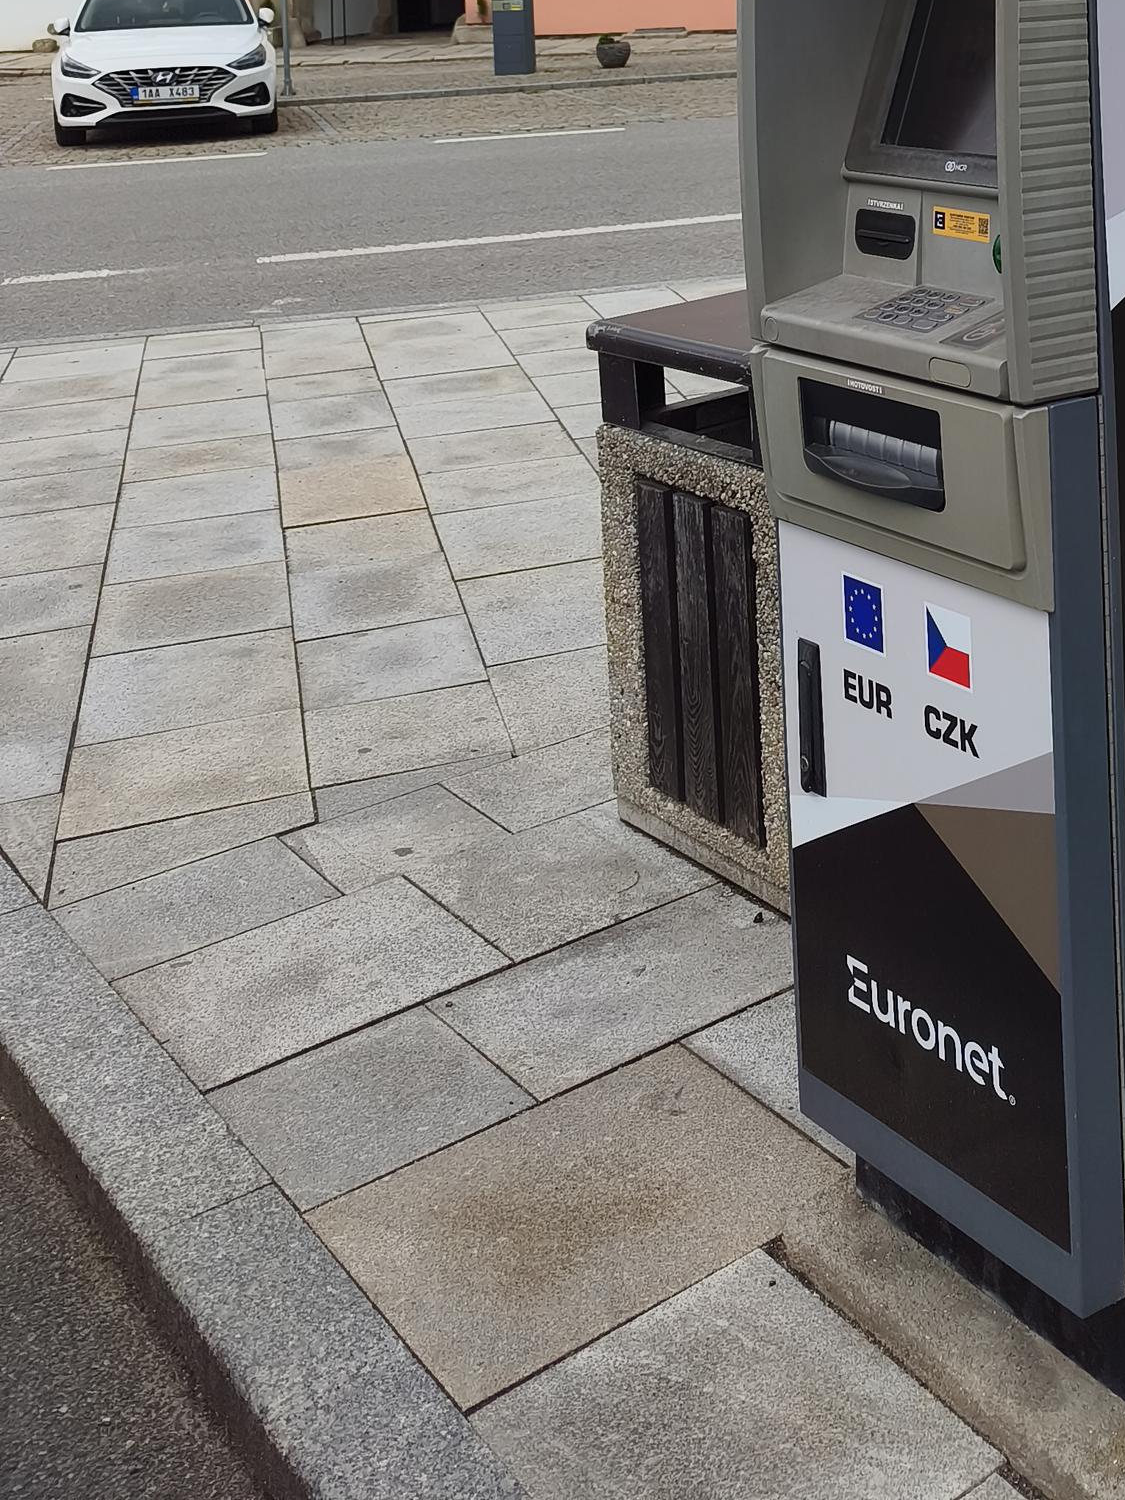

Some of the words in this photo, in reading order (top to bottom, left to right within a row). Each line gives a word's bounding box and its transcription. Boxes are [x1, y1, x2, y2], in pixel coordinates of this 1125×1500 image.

[142, 89, 160, 98] 1AA
[843, 668, 893, 720] EUR
[924, 704, 980, 759] CZK
[846, 954, 1008, 1101] Euronet
